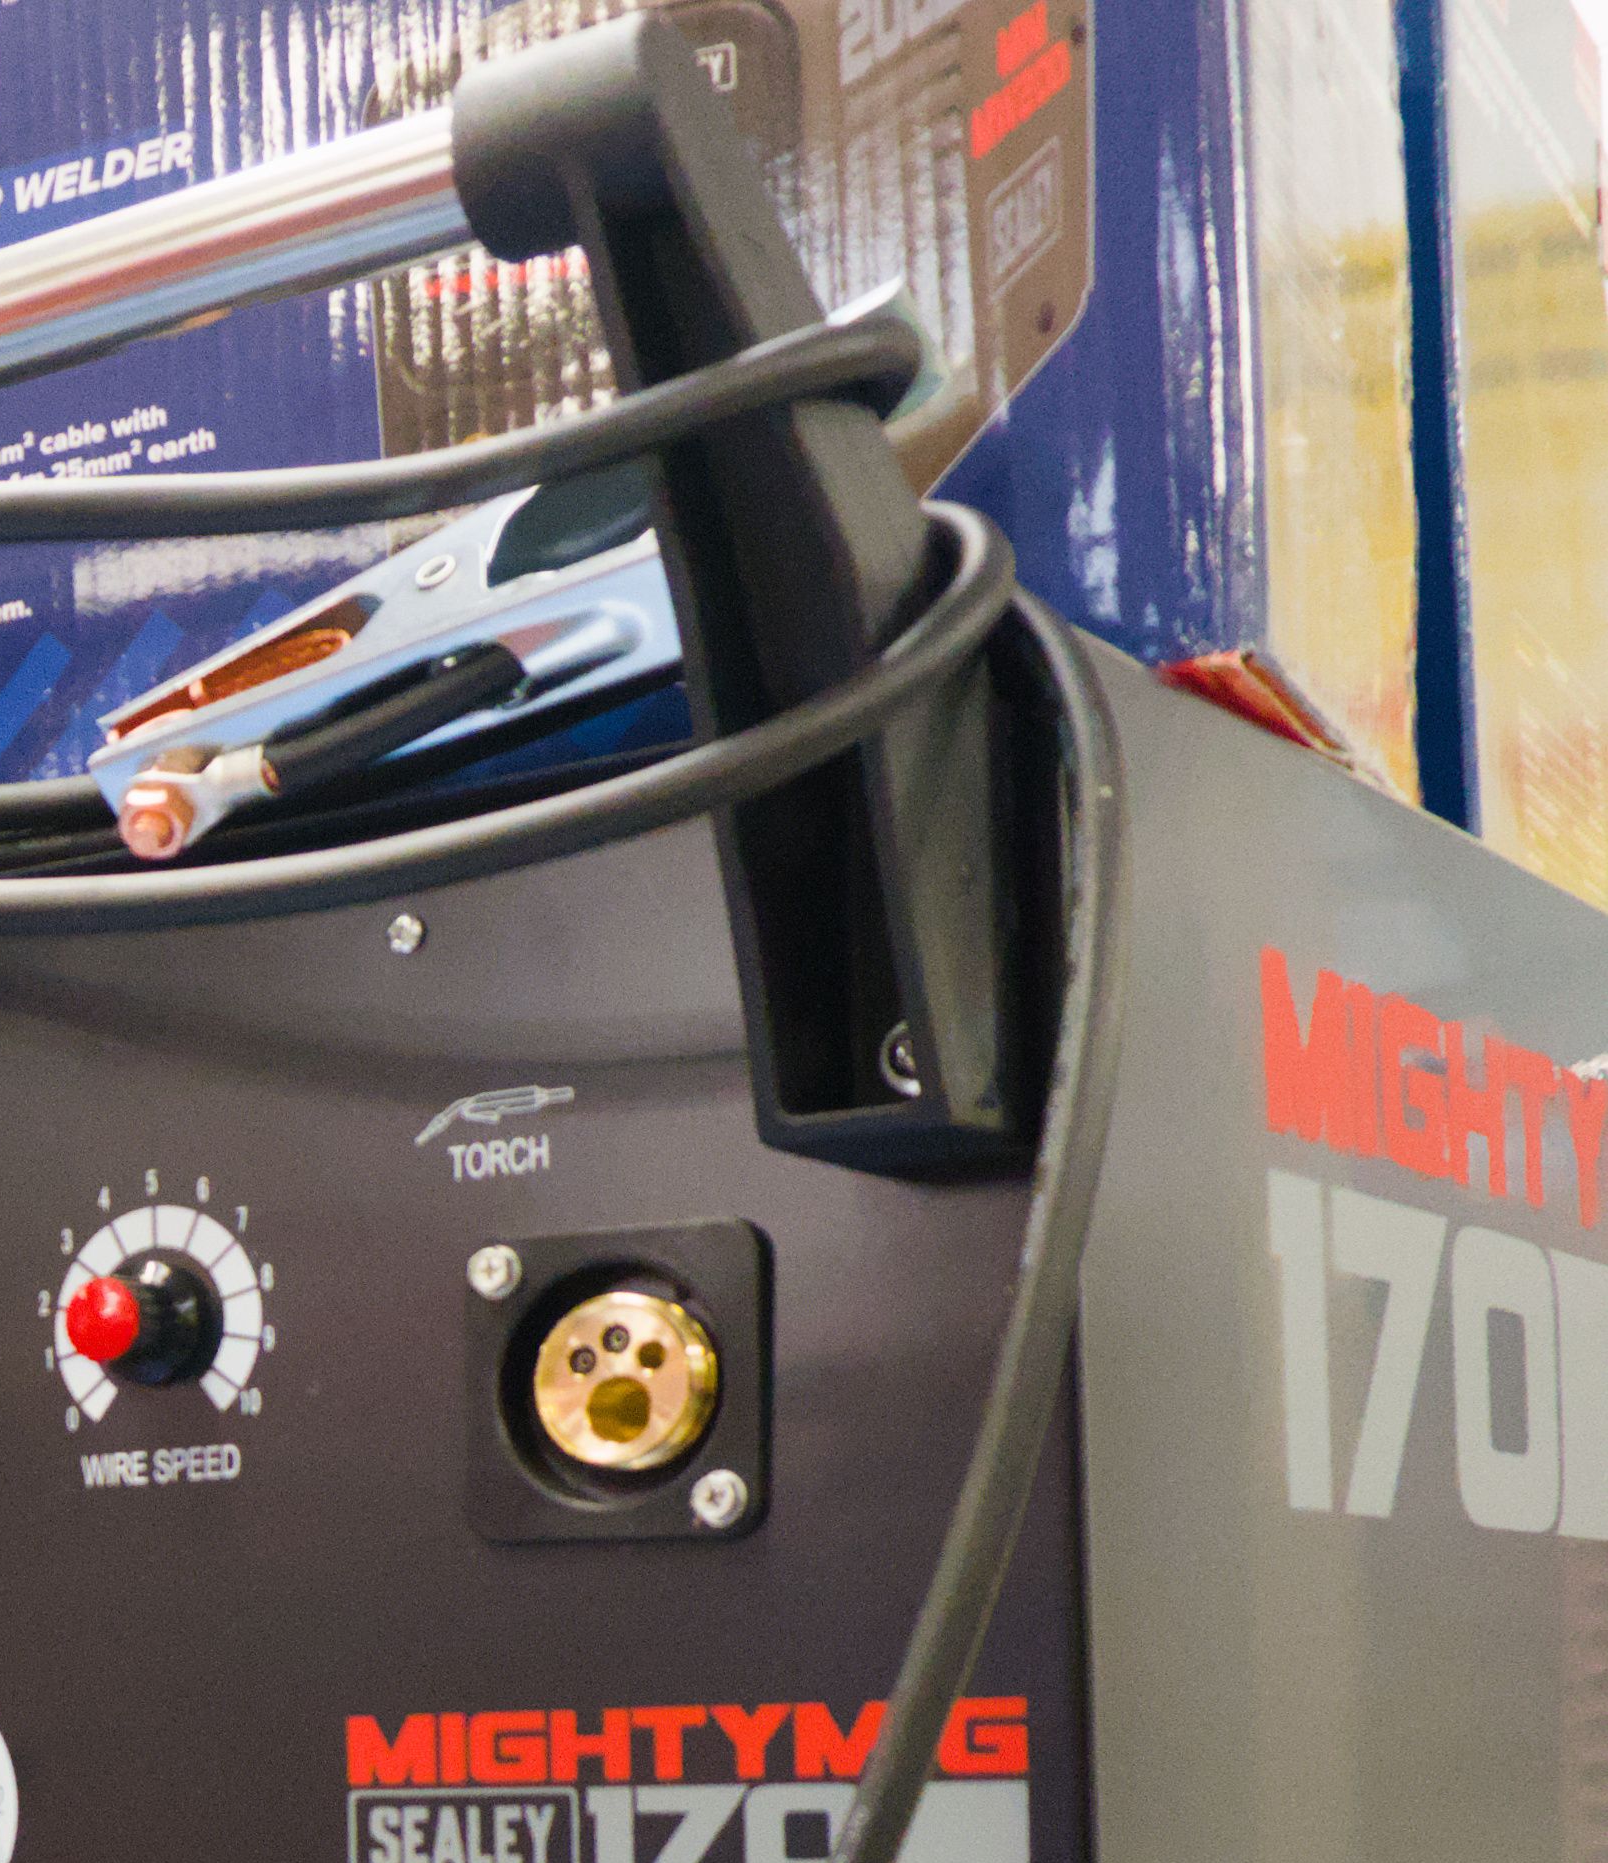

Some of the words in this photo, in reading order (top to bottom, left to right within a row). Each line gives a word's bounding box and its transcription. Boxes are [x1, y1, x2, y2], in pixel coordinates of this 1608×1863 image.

[14, 130, 192, 214] WELDER
[39, 419, 106, 455] cable
[111, 404, 168, 439] with
[147, 427, 216, 464] earth
[447, 1134, 550, 1182] TORCH
[145, 1168, 159, 1196] 5
[196, 1176, 210, 1202] 6
[98, 1186, 111, 1211] 4
[235, 1206, 248, 1232] 7
[60, 1228, 74, 1255] 3
[261, 1263, 274, 1292] 8
[38, 1290, 51, 1317] 2
[262, 1325, 276, 1352] 9
[1267, 1166, 1563, 1533] 170
[44, 1345, 54, 1371] 1
[240, 1387, 262, 1416] 10
[65, 1405, 80, 1433] 0
[81, 1451, 149, 1489] WIRE
[153, 1443, 242, 1484] SPEED
[346, 1695, 1029, 1786] MIGHTYMG
